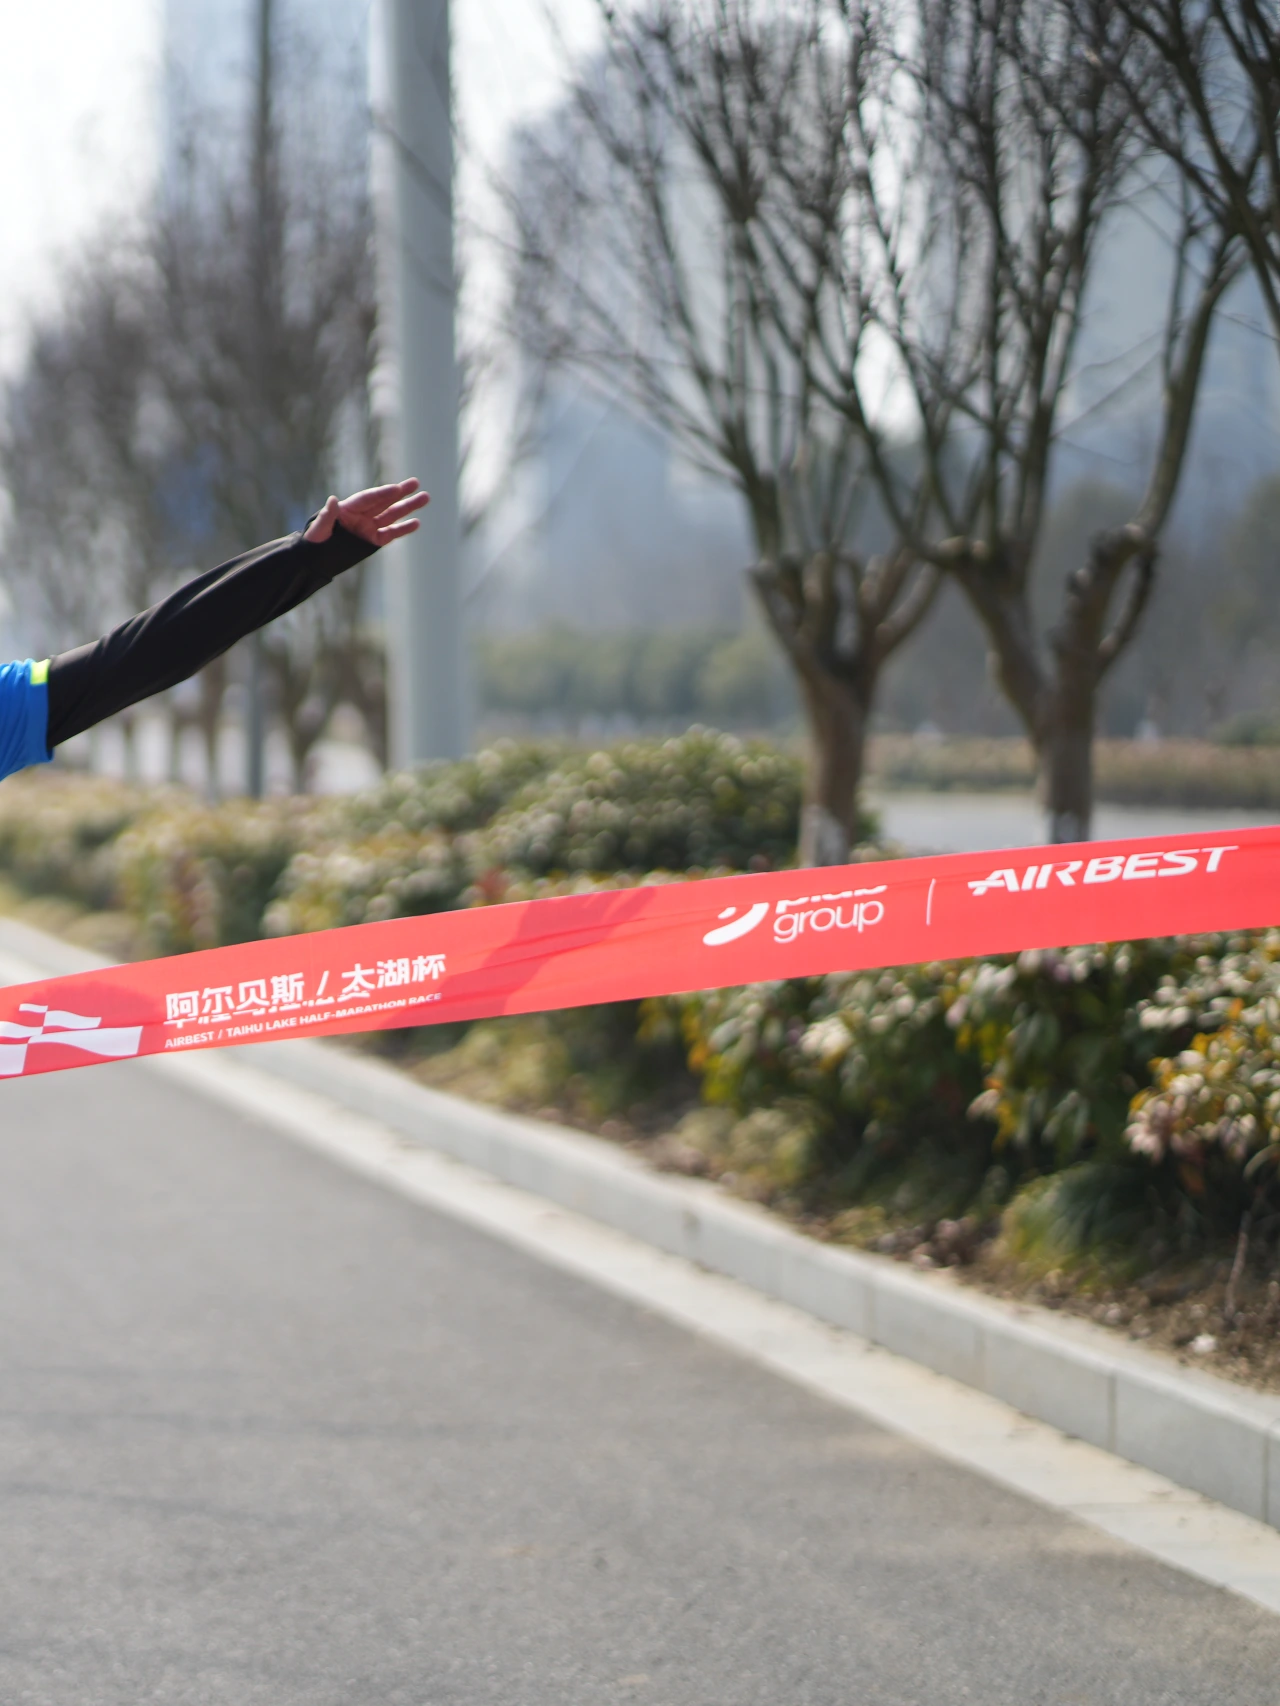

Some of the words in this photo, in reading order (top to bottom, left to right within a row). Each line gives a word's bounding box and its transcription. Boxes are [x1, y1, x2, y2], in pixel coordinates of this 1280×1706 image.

[967, 845, 1239, 896] AIRBEST
[773, 900, 885, 943] group
[165, 972, 305, 1020] 阿尔贝斯
[341, 953, 447, 994] 太湖杯
[164, 1031, 215, 1049] AIRBEST
[226, 1022, 263, 1038] TAIHU
[266, 1017, 297, 1031] LAKE
[299, 999, 406, 1025] HALF-MARATHON
[408, 993, 442, 1006] RACE
